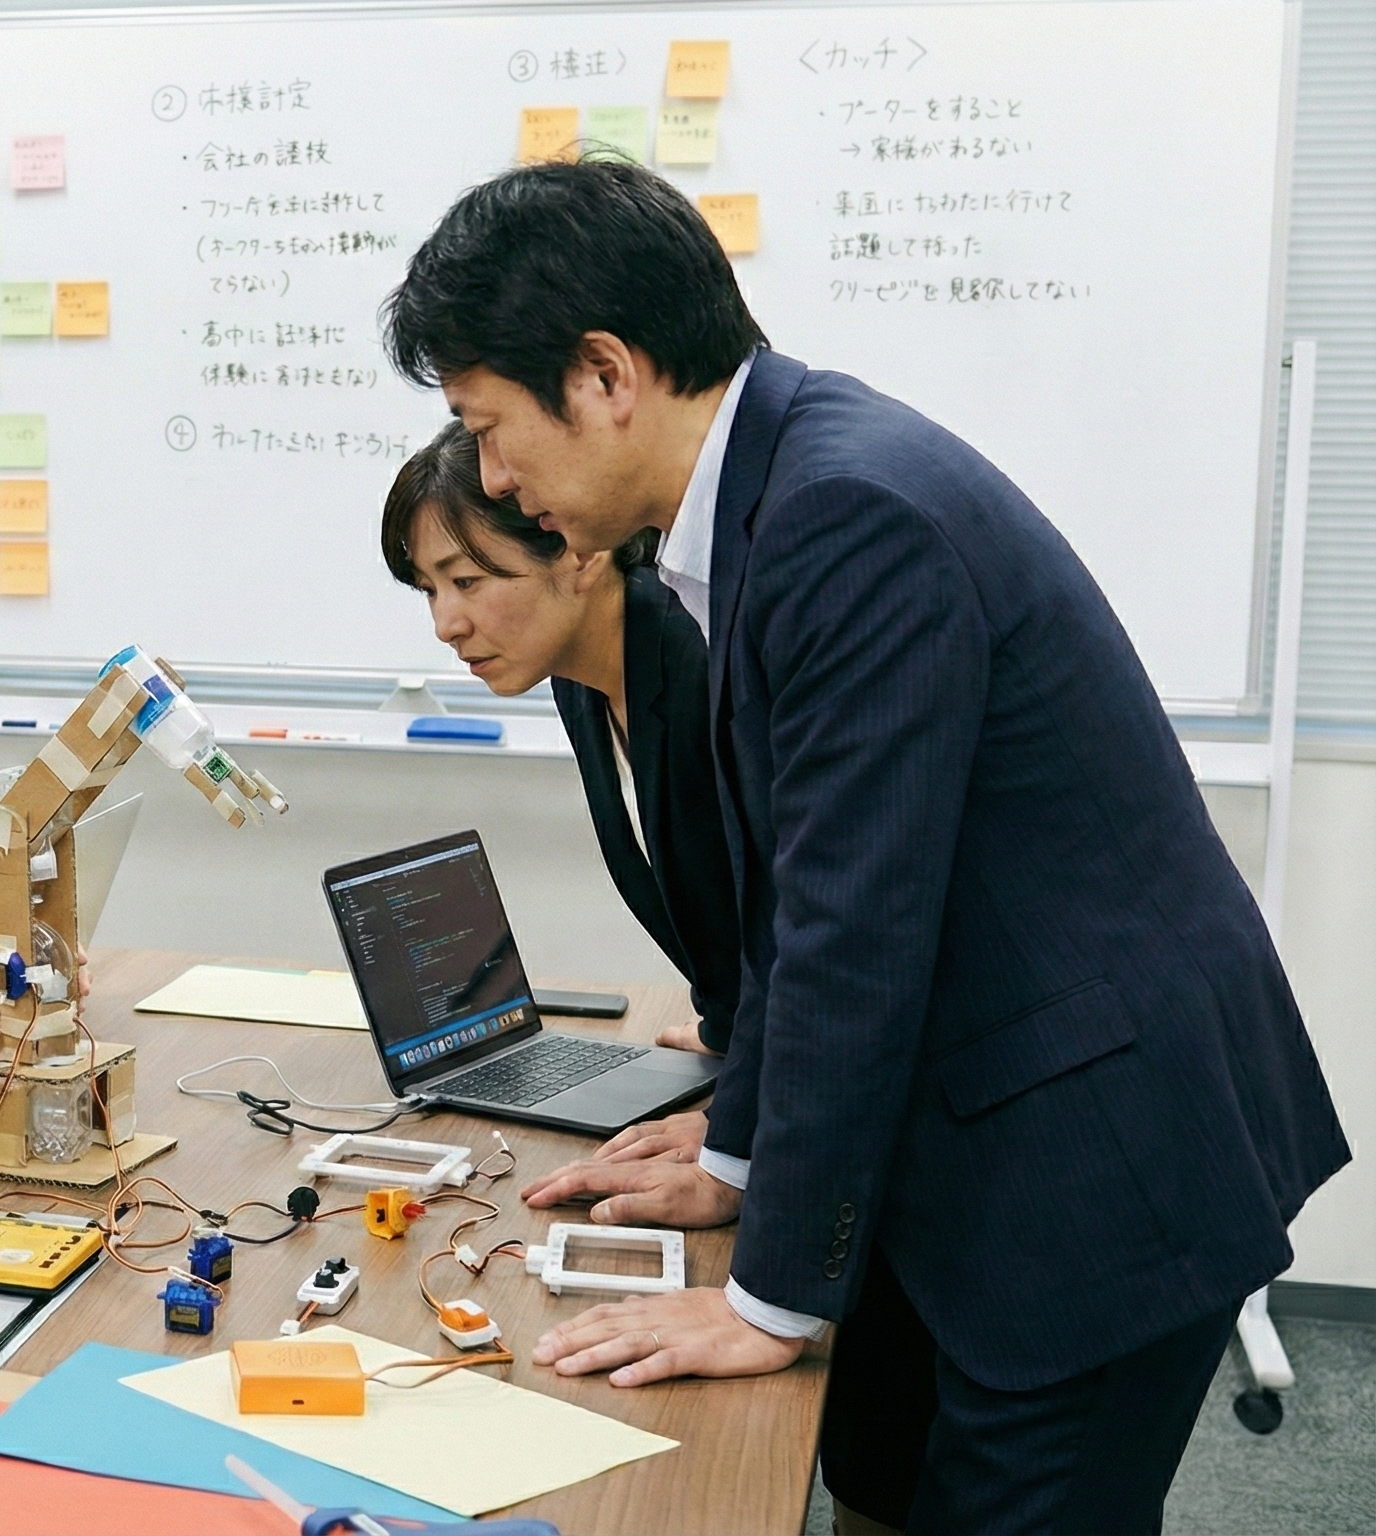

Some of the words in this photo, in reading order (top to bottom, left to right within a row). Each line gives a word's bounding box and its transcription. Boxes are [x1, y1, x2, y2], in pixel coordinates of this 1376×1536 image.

[507, 49, 539, 83] ③
[151, 84, 187, 123] ②
[164, 414, 197, 453] ④
